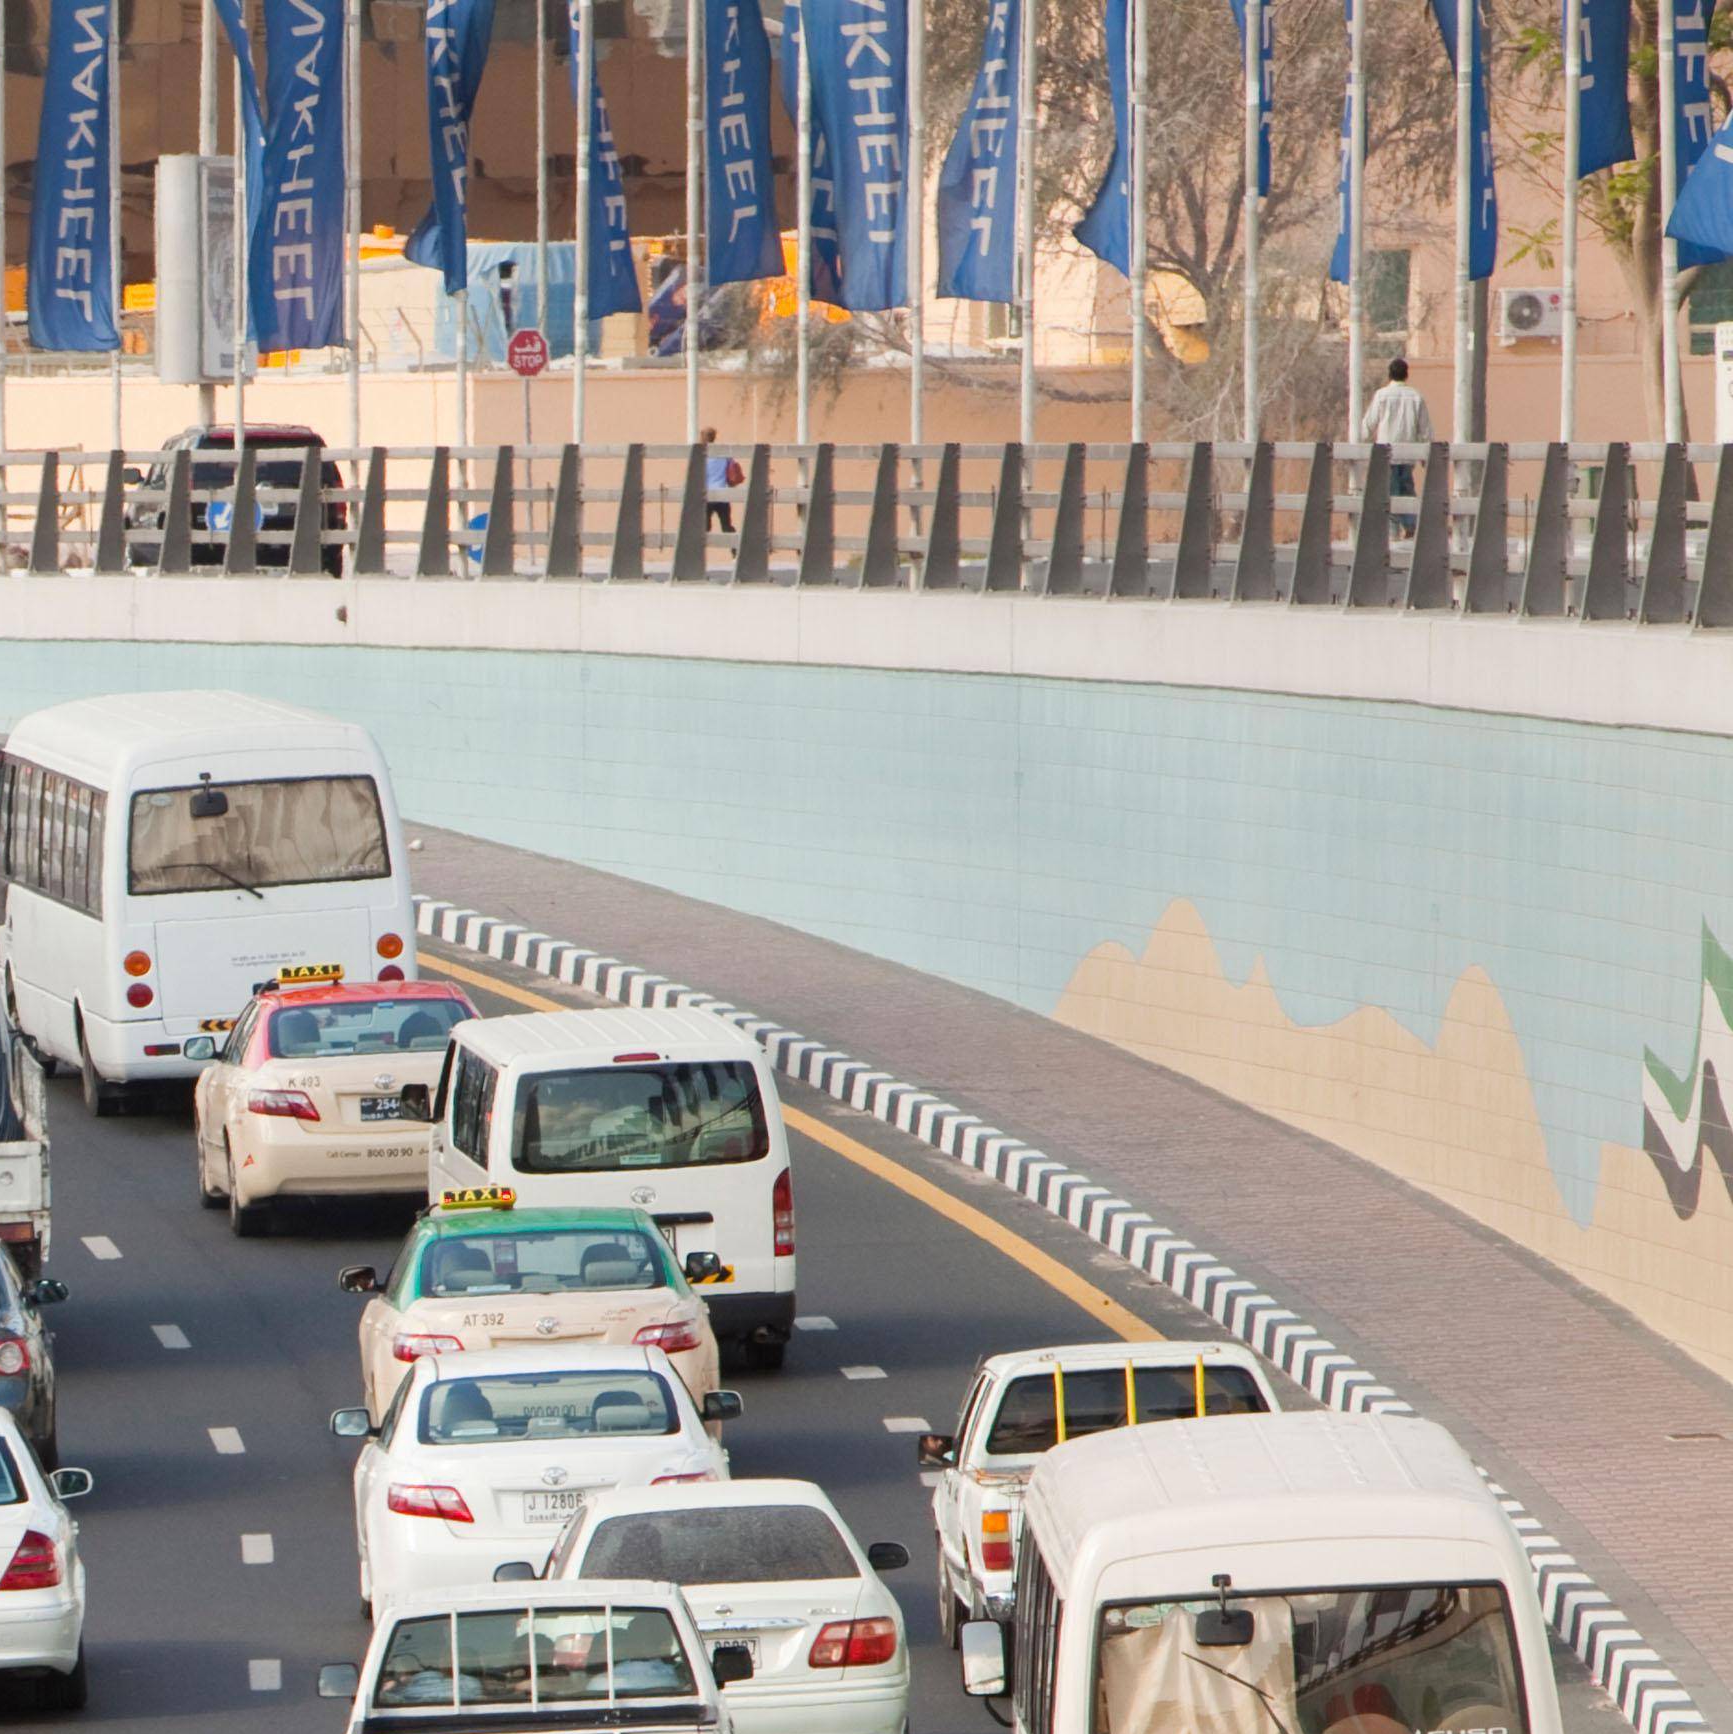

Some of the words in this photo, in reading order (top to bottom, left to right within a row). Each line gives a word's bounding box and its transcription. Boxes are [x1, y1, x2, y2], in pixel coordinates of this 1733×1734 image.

[513, 334, 543, 354] قف
[511, 353, 548, 370] STOP
[290, 965, 334, 977] TAXI
[288, 1078, 296, 1088] K
[301, 1076, 321, 1088] 493
[367, 1149, 385, 1158] 800
[401, 1148, 413, 1157] 90
[452, 1188, 503, 1201] TAXI
[464, 1315, 479, 1327] AT
[482, 1313, 505, 1326] 392
[528, 1495, 536, 1510] J
